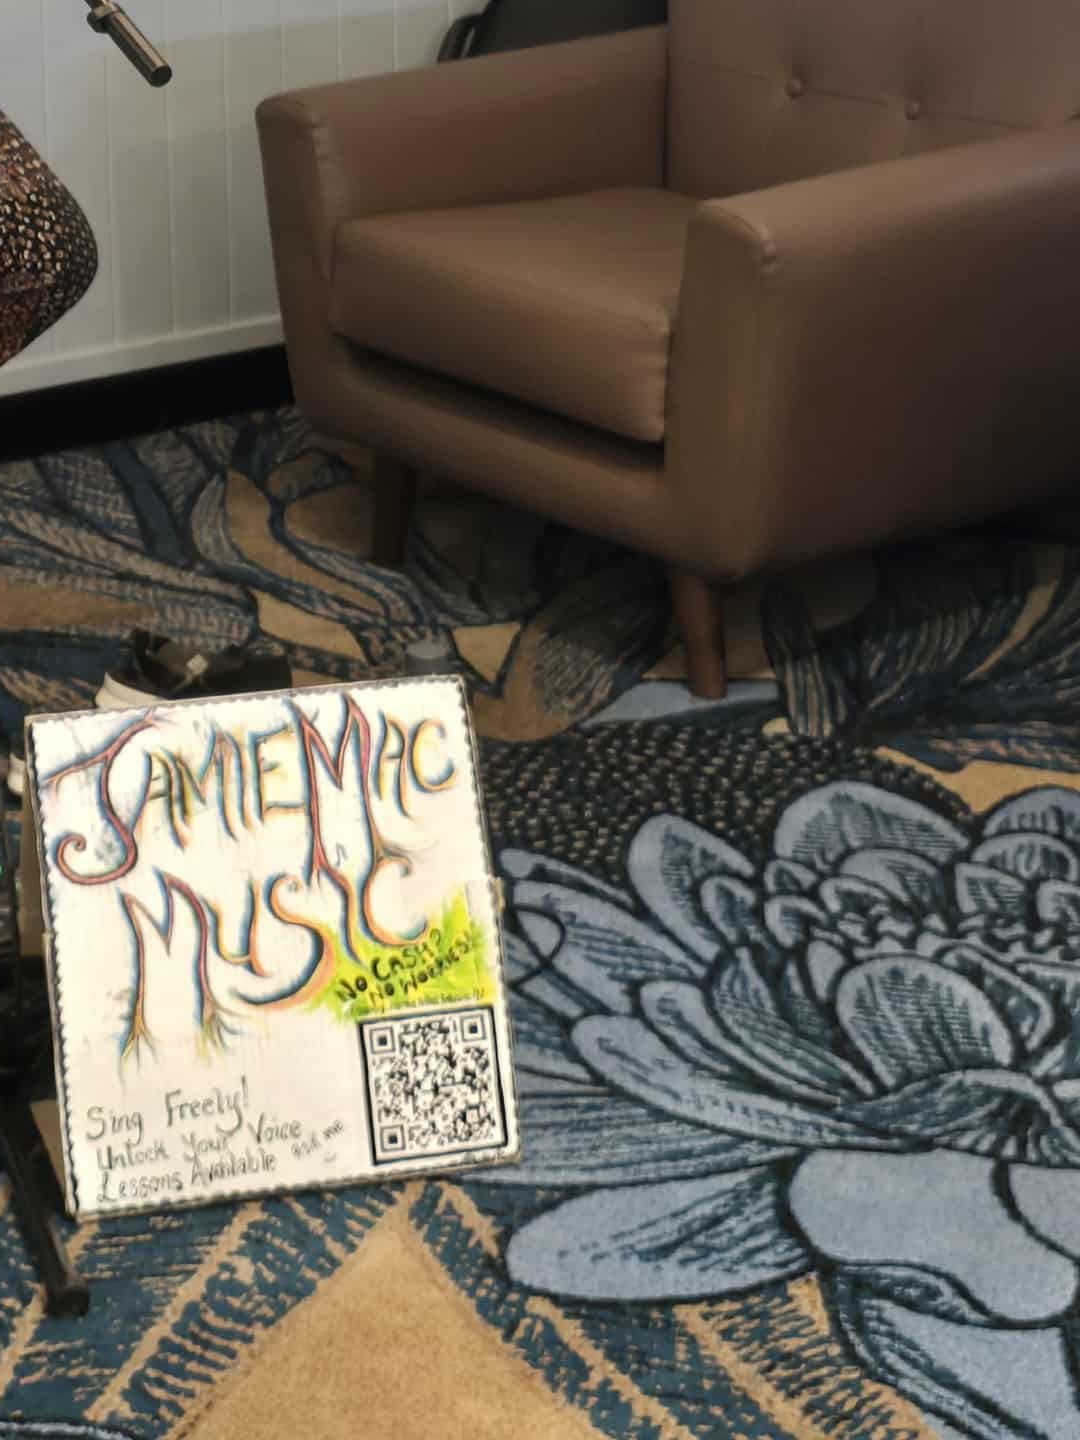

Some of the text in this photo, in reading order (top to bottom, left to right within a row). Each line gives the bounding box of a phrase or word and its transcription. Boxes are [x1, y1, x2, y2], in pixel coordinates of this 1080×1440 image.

[115, 856, 430, 1062] MUSIC
[86, 1075, 248, 1145] Sing Freely!
[96, 1112, 302, 1171] Unlock Your Voice
[96, 1147, 276, 1203] Lessons Available
